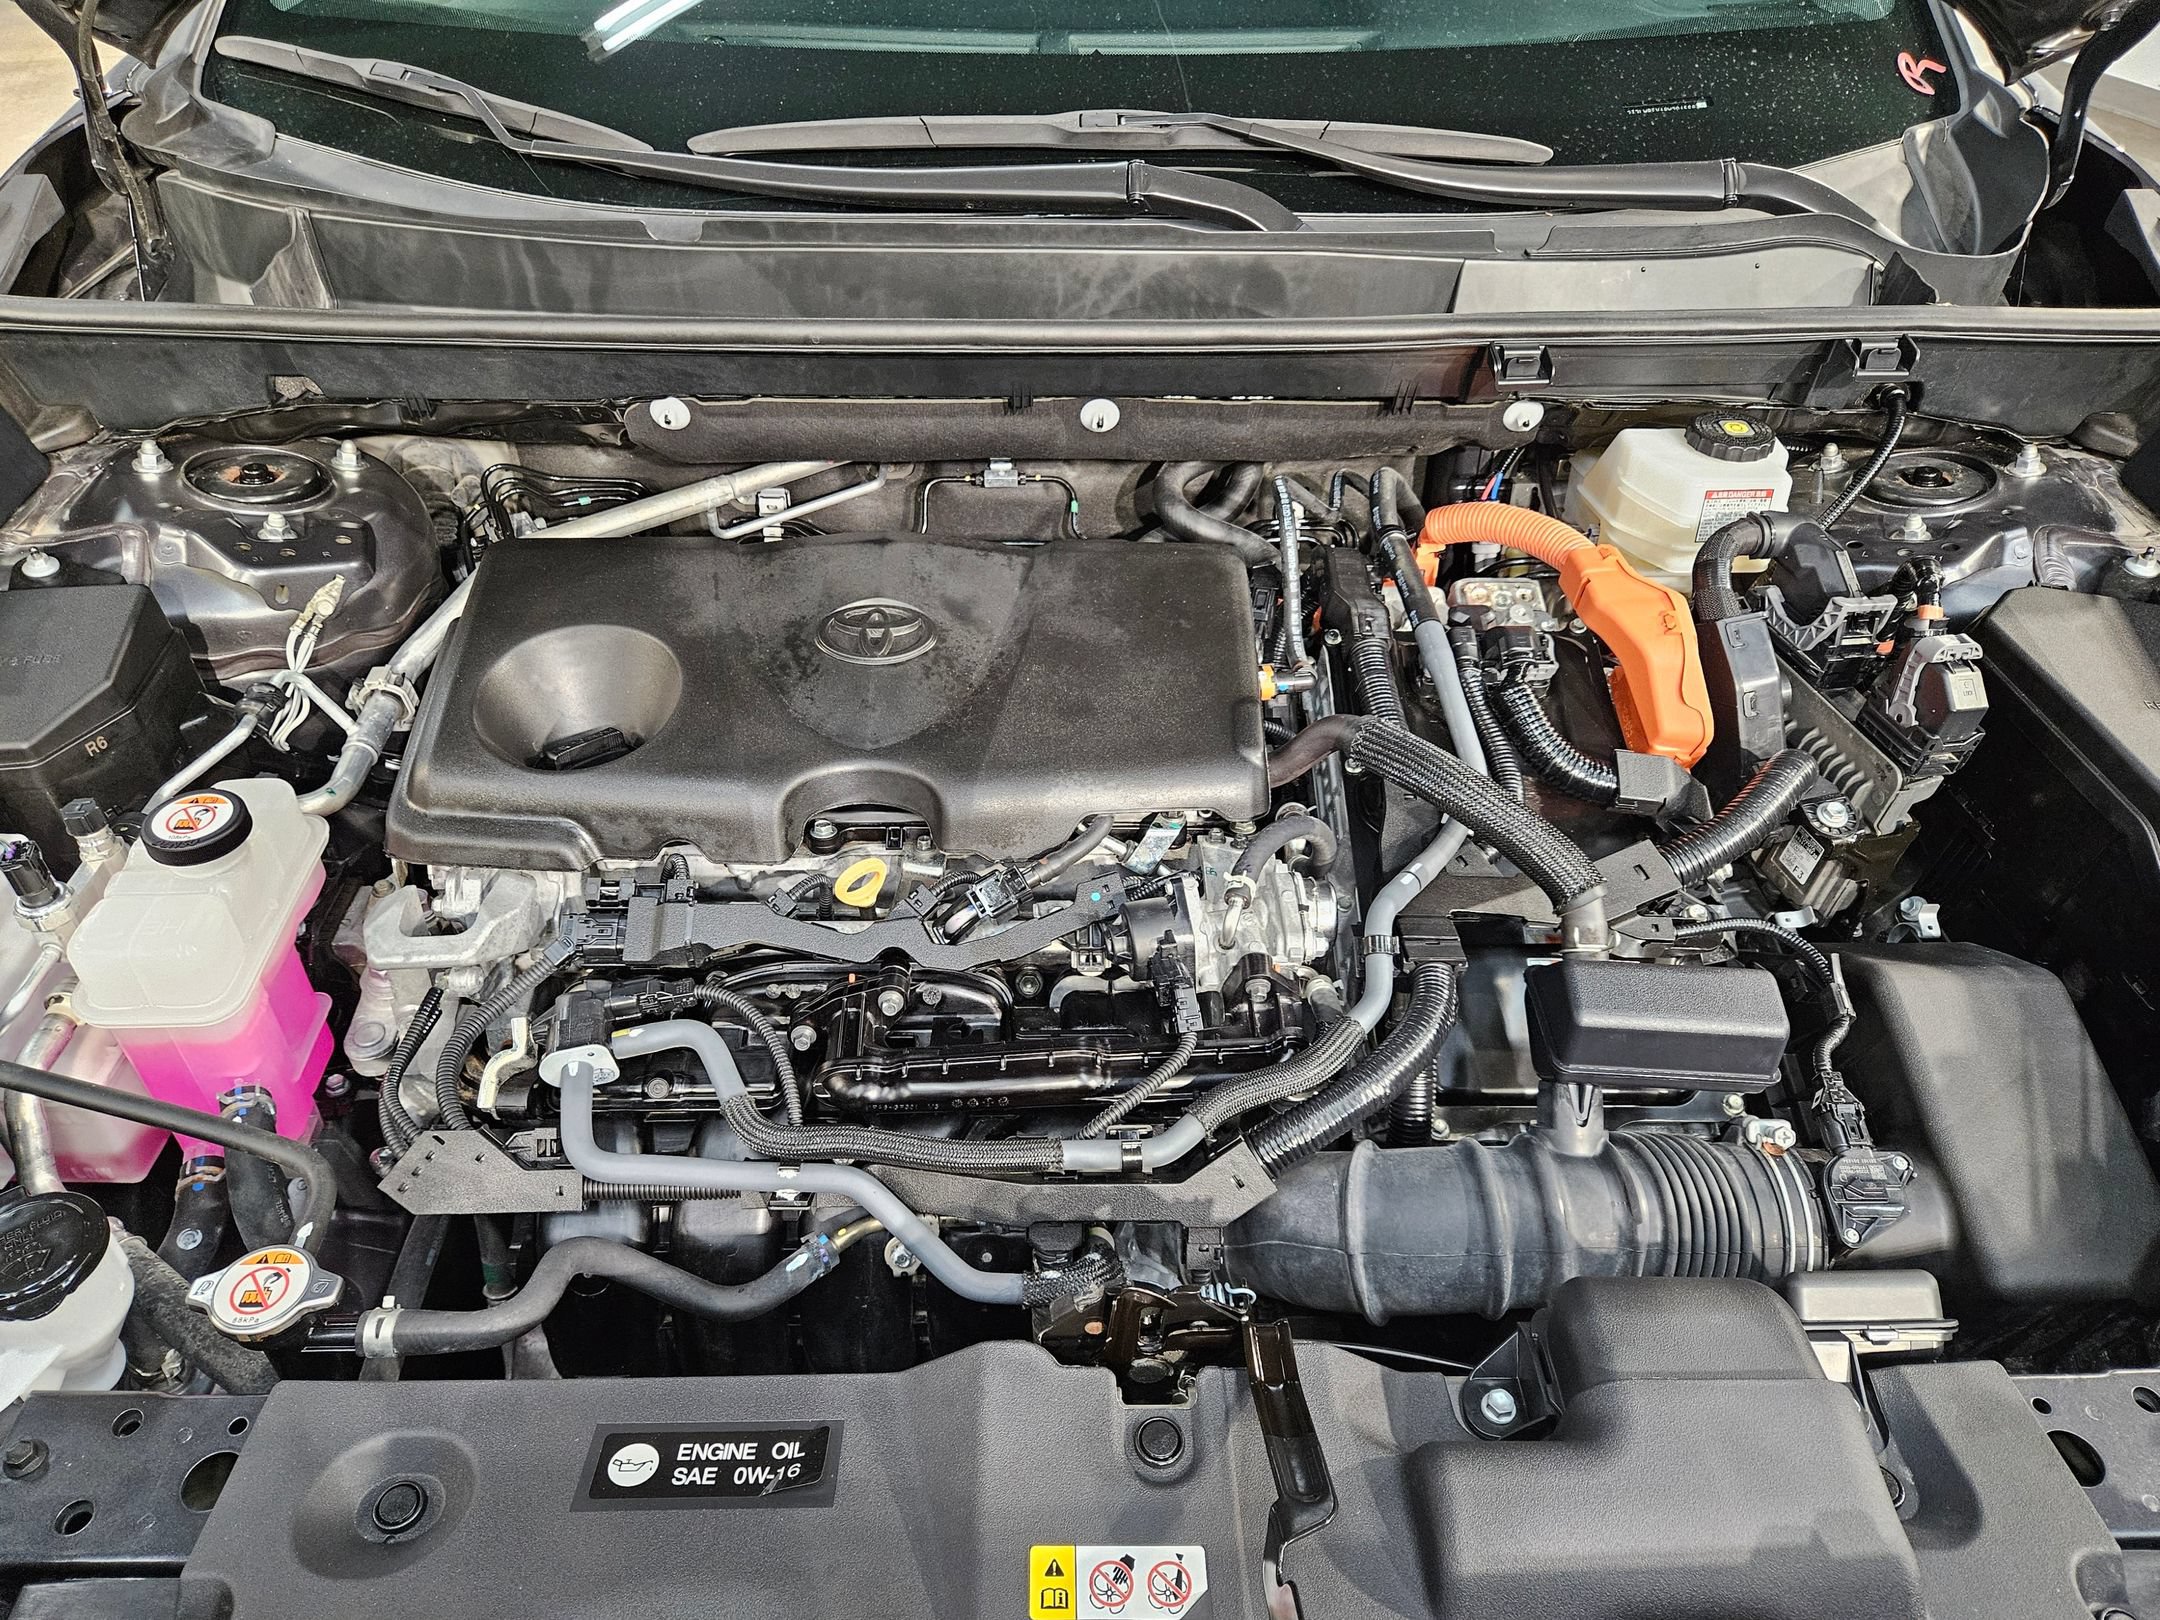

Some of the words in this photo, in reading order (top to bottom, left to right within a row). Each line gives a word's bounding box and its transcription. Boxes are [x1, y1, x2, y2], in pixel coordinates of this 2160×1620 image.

[84, 736, 108, 757] R6
[29, 1210, 64, 1230] FLUID
[4, 1232, 35, 1250] ONLY
[676, 1442, 758, 1461] ENGINE
[771, 1441, 806, 1460] OIL
[671, 1467, 718, 1485] SAE
[733, 1463, 802, 1485] 0W-16
